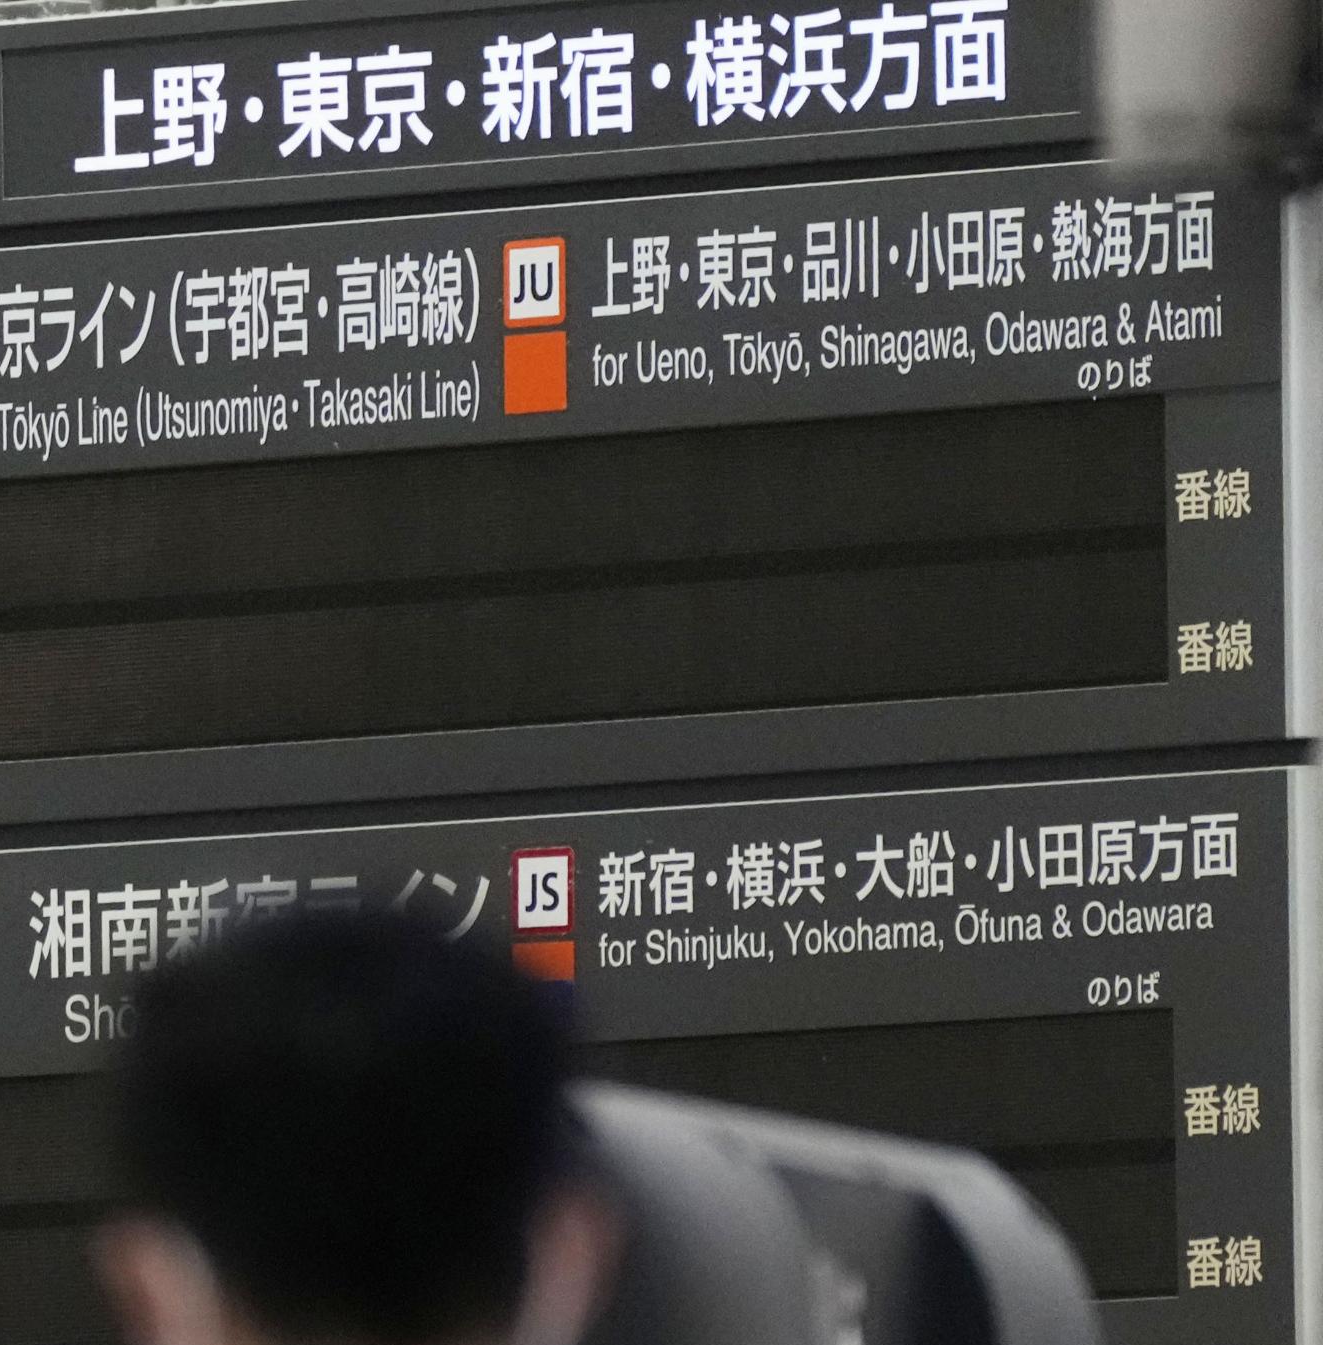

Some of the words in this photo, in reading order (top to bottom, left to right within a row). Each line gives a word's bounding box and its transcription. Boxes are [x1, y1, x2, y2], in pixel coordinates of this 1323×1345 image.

[74, 0, 1009, 174] 上野・東京・新宿・横浜方面
[591, 191, 1216, 318] 上野・東京・品川・小田原・熱海方面
[514, 261, 555, 304] JU
[592, 343, 626, 388] for
[636, 341, 716, 387] Ueno,
[723, 330, 813, 386] Tōkyō,
[819, 321, 978, 376] Shinagawa,
[985, 303, 1108, 354] Odawara
[1116, 303, 1138, 345] &
[1144, 295, 1224, 341] Atami
[1077, 354, 1154, 391] のりば
[77, 401, 129, 447] Line
[420, 360, 482, 424] Line)
[1174, 467, 1252, 523] 番線
[1176, 621, 1254, 675] 番線
[524, 870, 560, 915] JS
[598, 812, 1240, 919] 新宿・横浜・大船・小田原方面
[598, 933, 636, 969] for
[644, 927, 775, 971] Shinjuku,
[783, 916, 946, 958] Yokohama,
[955, 903, 1043, 947] Ōfuna
[1052, 904, 1074, 940] &
[1082, 897, 1215, 937] Odawara
[1086, 972, 1161, 1007] のりば
[1183, 1081, 1263, 1136] 番線
[1185, 1235, 1265, 1289] 番線
